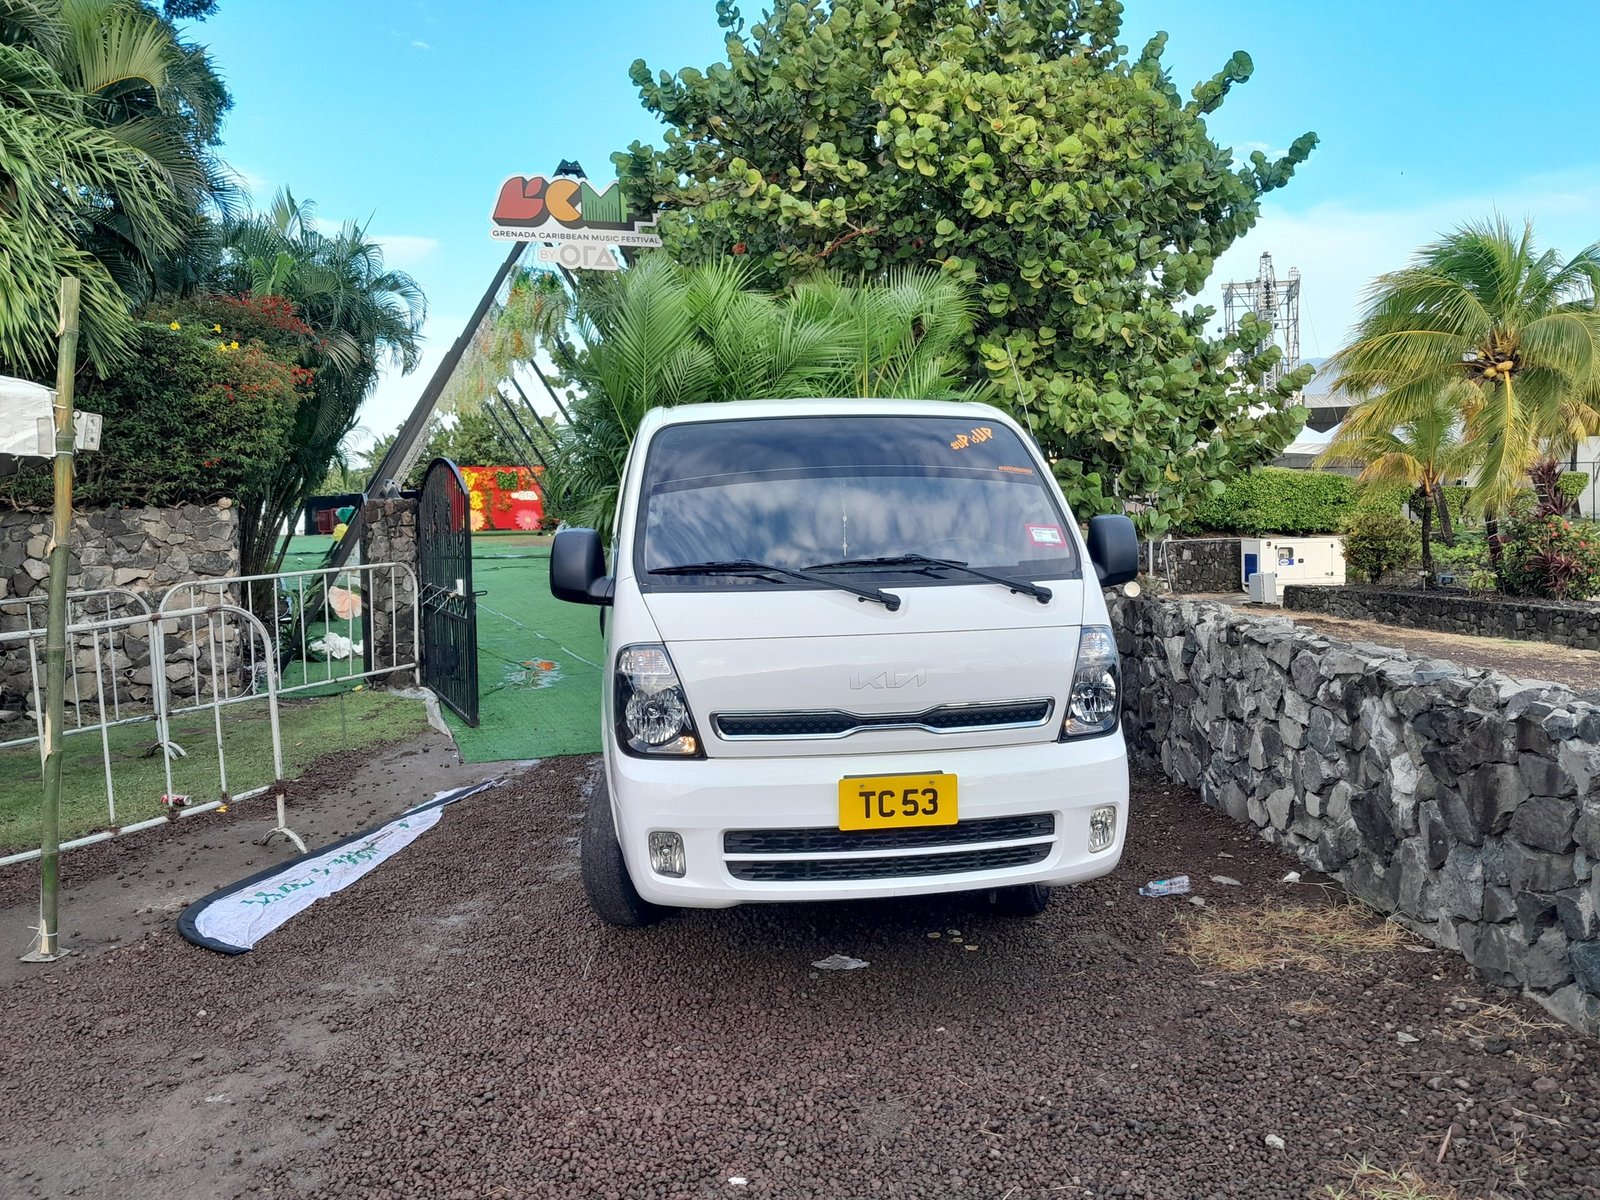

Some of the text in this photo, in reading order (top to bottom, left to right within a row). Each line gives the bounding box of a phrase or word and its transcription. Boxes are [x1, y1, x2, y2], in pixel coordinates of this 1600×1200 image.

[492, 229, 660, 245] GRENADA CARIBBEAN MUSIC FESTIVAL
[540, 249, 556, 259] BY
[849, 666, 928, 690] KIA
[858, 787, 939, 819] TC 53
